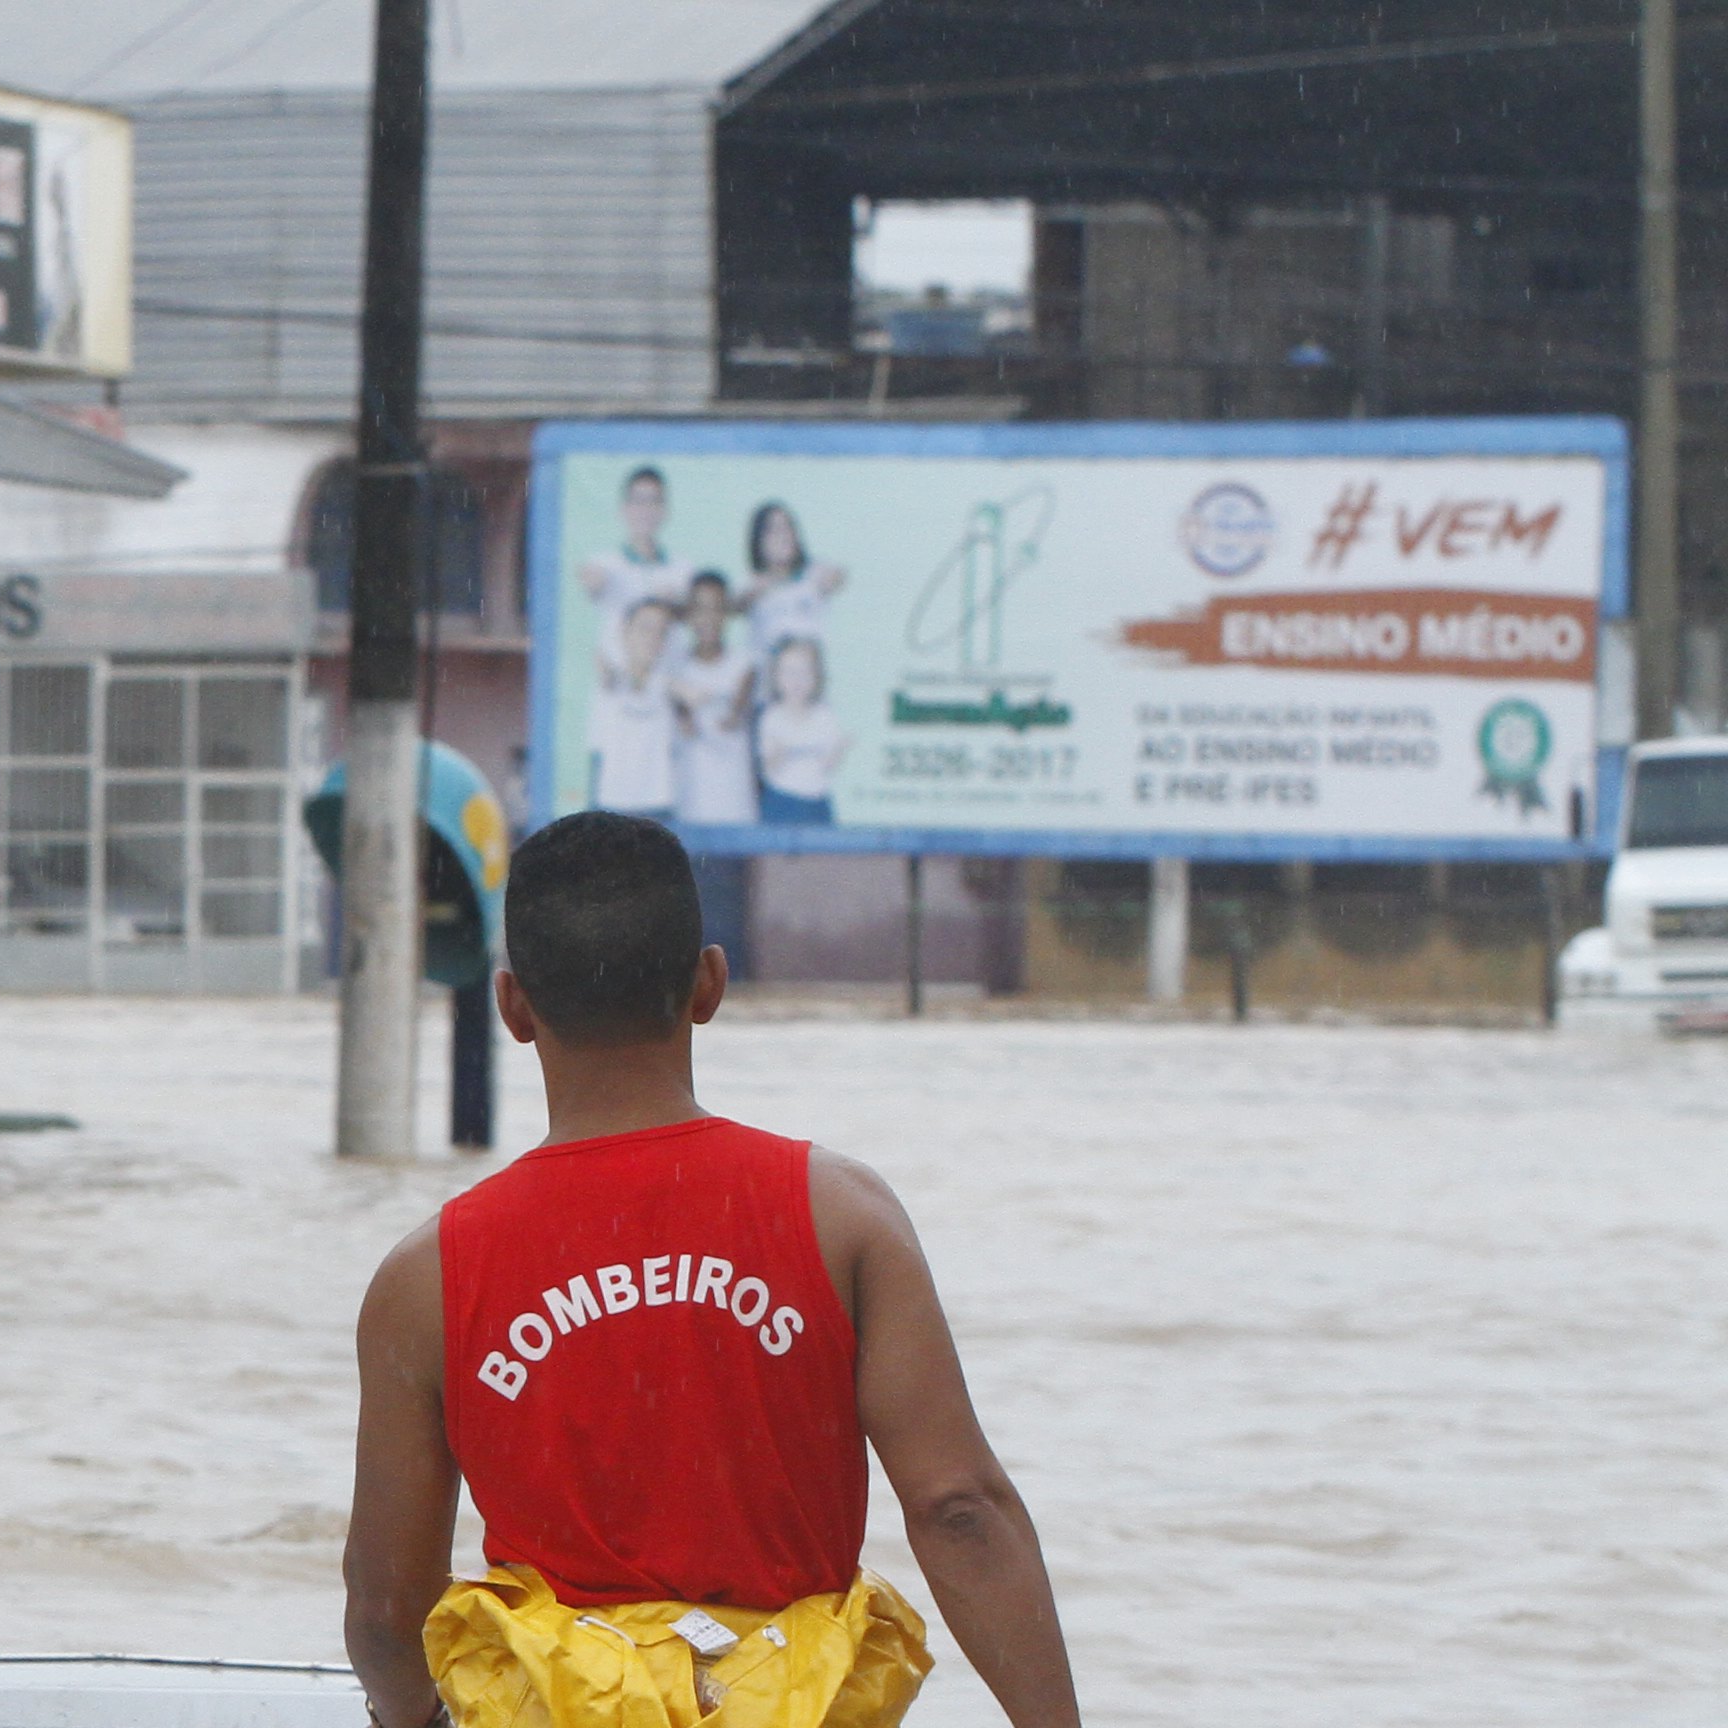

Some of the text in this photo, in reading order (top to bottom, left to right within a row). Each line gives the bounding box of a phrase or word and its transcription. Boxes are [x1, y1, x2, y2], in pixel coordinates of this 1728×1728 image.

[1221, 604, 1585, 663] ENSINO MÉDIO
[1195, 736, 1317, 766] ENSINO
[1330, 731, 1440, 768] MÉDIO
[477, 1254, 805, 1402] BOMBEIROS
